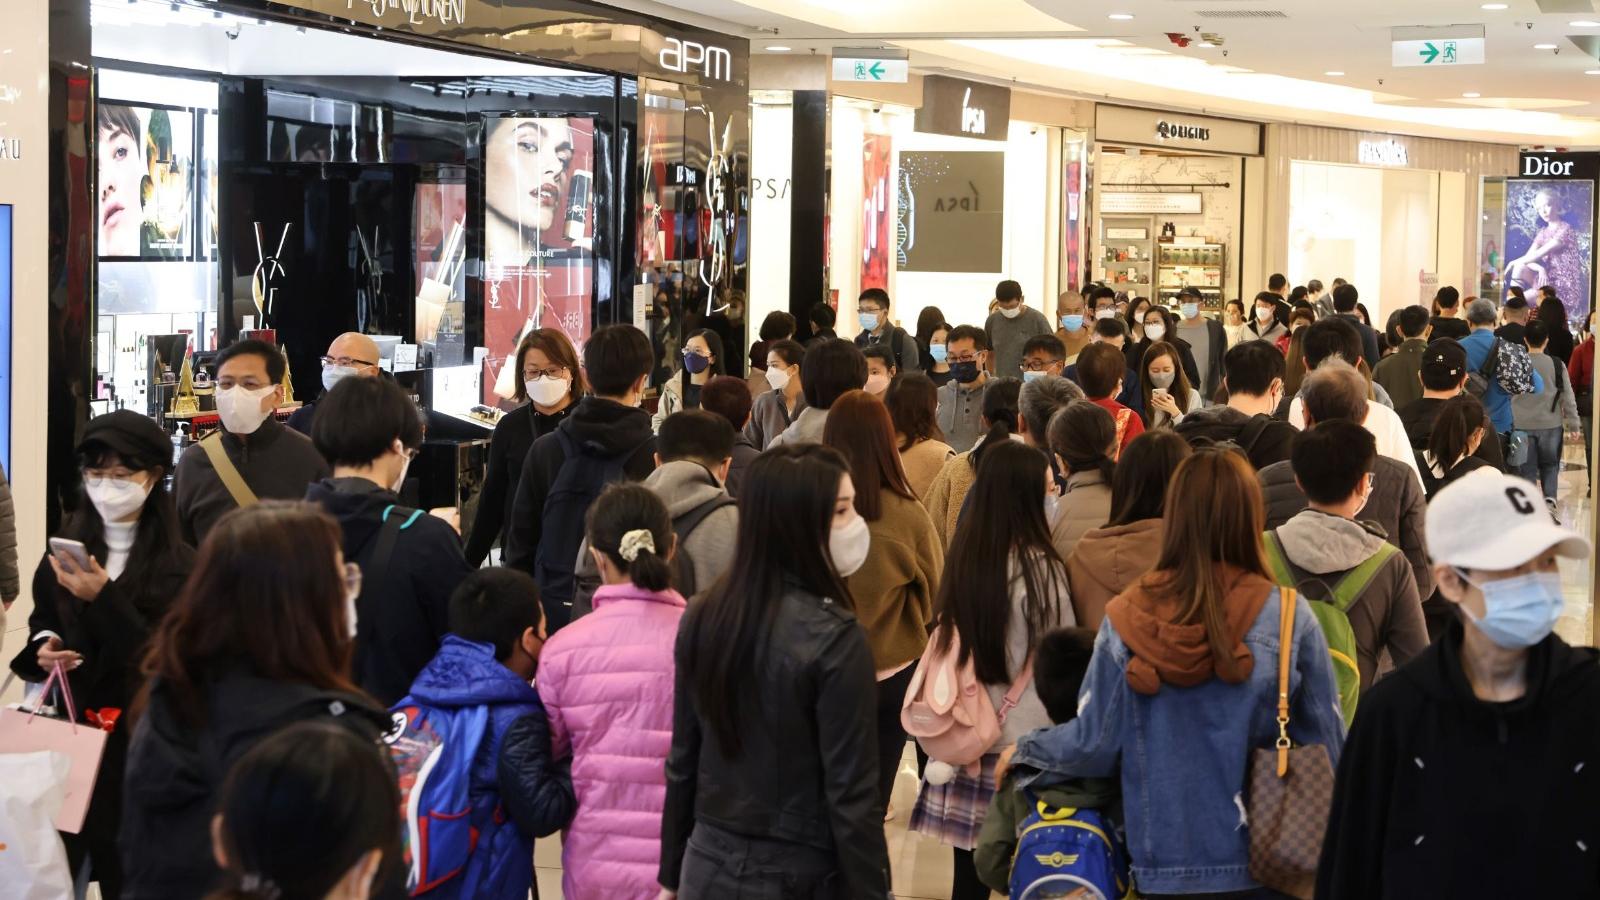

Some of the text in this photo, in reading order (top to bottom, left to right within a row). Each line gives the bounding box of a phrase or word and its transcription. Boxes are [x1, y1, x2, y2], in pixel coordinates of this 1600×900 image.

[1170, 125, 1210, 140] ORIGINS
[1522, 156, 1574, 176] Dior
[1505, 487, 1535, 515] C
